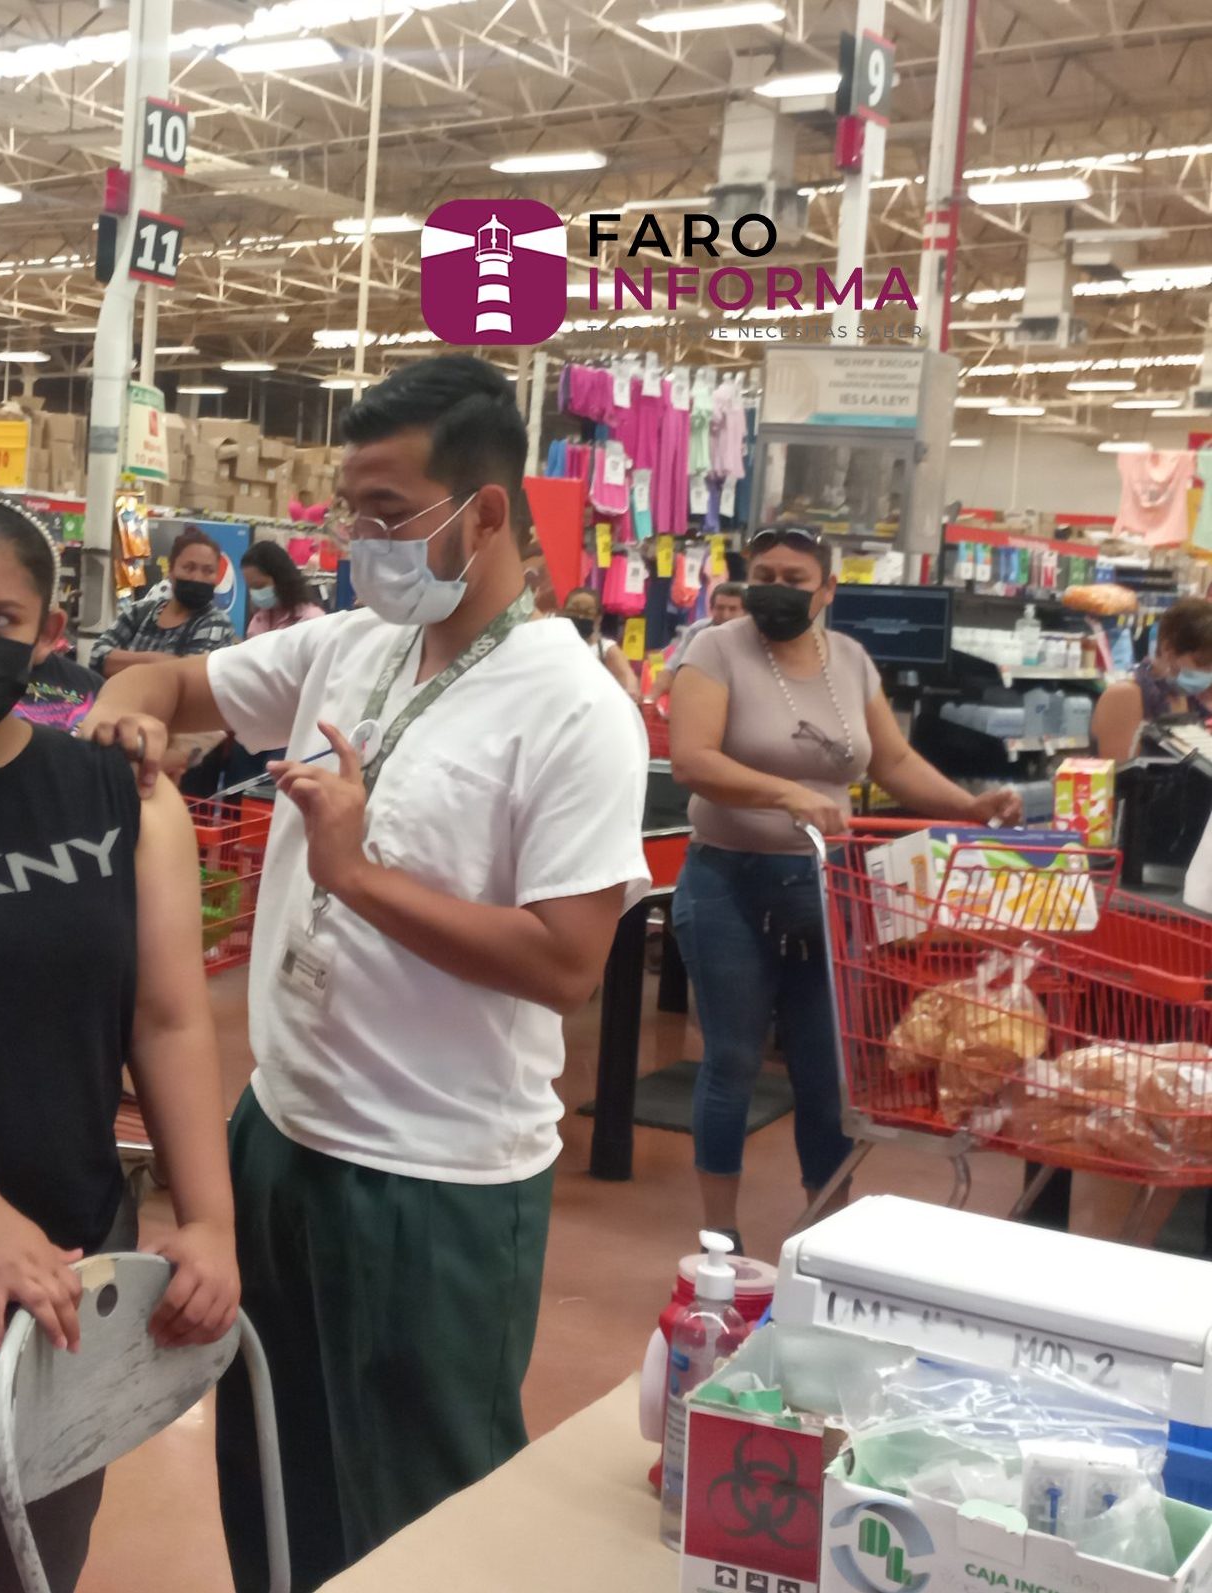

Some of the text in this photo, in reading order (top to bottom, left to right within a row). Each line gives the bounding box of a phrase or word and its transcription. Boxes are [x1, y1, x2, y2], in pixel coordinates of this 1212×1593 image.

[868, 49, 885, 107] 9
[147, 110, 186, 163] 10
[137, 224, 179, 276] 11
[860, 394, 879, 405] LA
[964, 1563, 1009, 1586] CAJA
